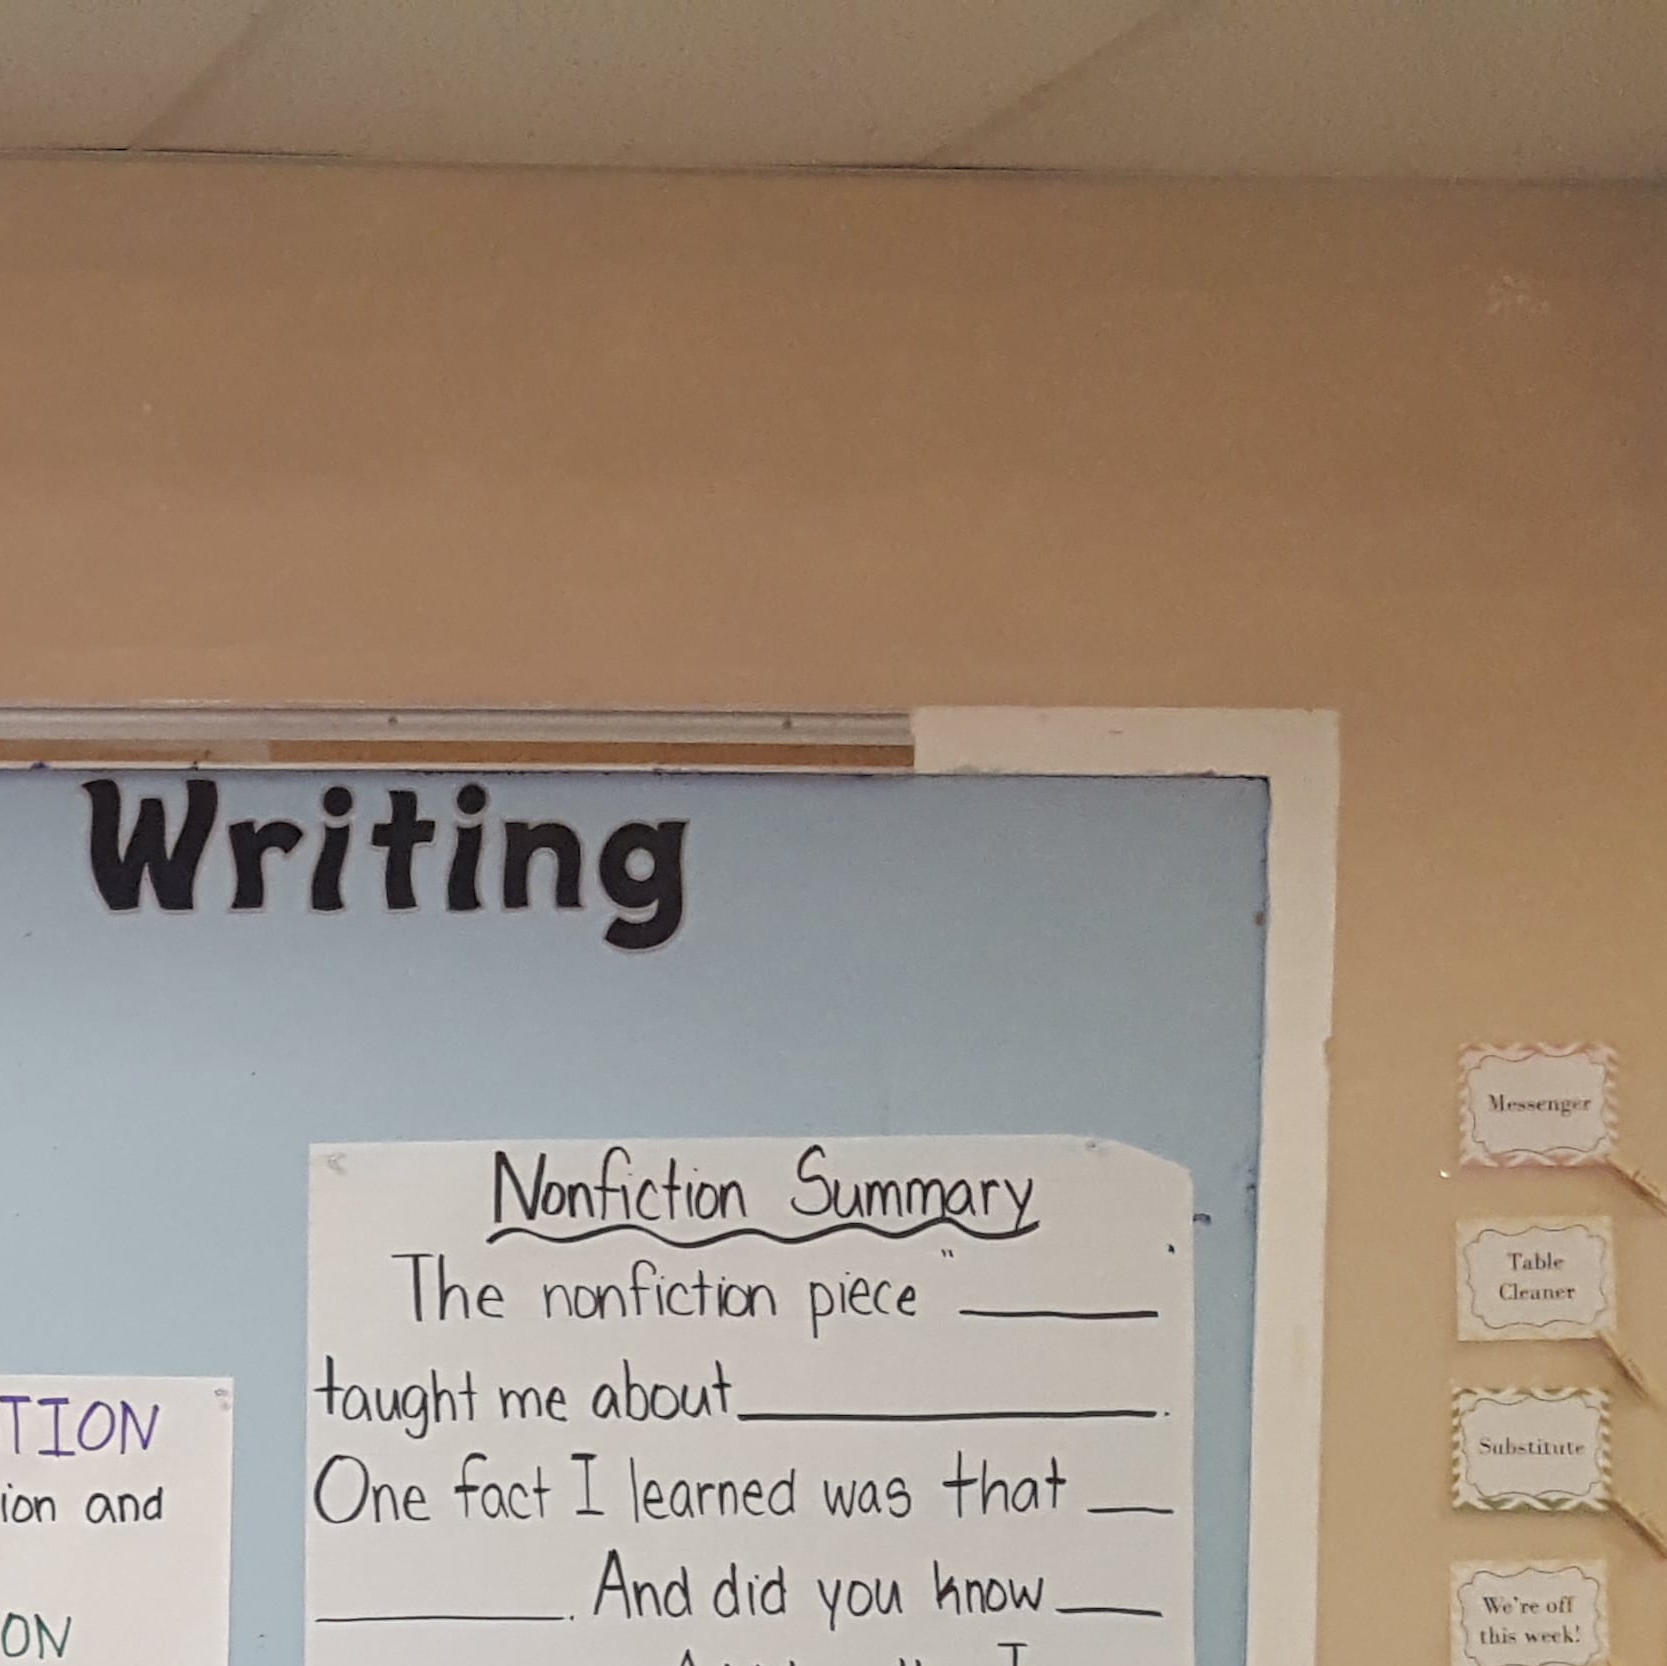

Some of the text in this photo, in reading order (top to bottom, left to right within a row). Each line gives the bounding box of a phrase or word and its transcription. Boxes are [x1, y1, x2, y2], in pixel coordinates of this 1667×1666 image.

[81, 777, 690, 952] Writing
[1487, 1094, 1591, 1114] Messenger
[489, 1144, 1040, 1228] Nonfiction Summary
[1506, 1253, 1564, 1272] Table
[390, 1252, 917, 1340] The nonfiction piece
[1498, 1283, 1576, 1302] Cleaner
[1479, 1437, 1586, 1457] Substitute
[84, 1485, 164, 1525] and
[592, 1547, 1045, 1632] And did you know
[1483, 1597, 1575, 1616] We're off
[1479, 1625, 1580, 1645] this week!
